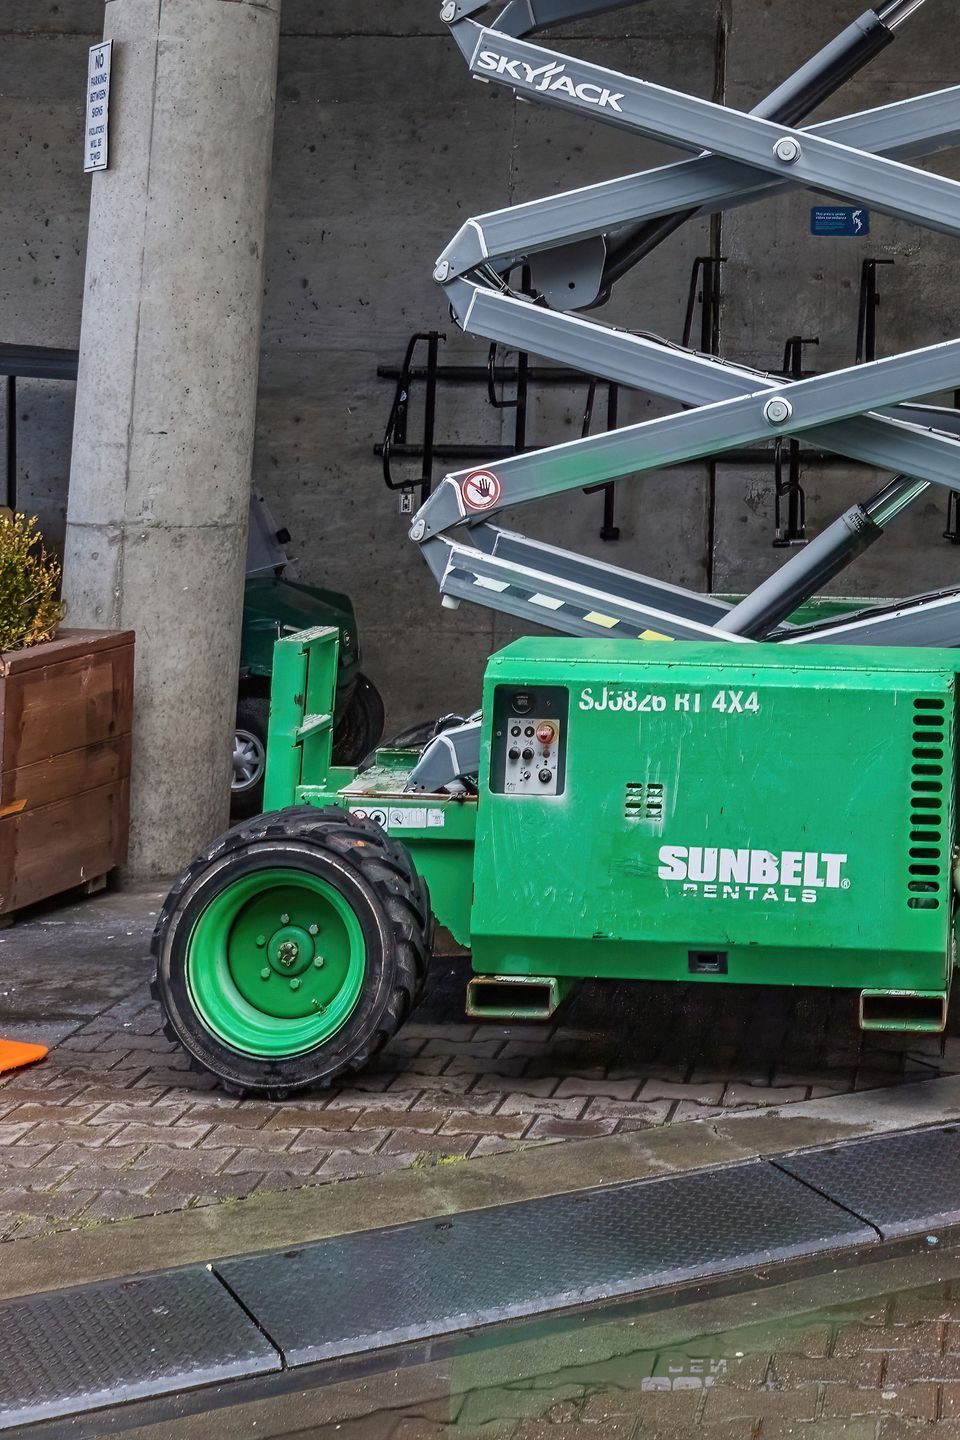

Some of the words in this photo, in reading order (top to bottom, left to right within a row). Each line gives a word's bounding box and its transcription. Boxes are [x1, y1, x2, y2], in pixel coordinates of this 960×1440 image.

[95, 53, 104, 69] NO
[477, 51, 624, 112] SKYJACK
[712, 691, 760, 713] 4X4
[683, 884, 817, 903] RENTALS
